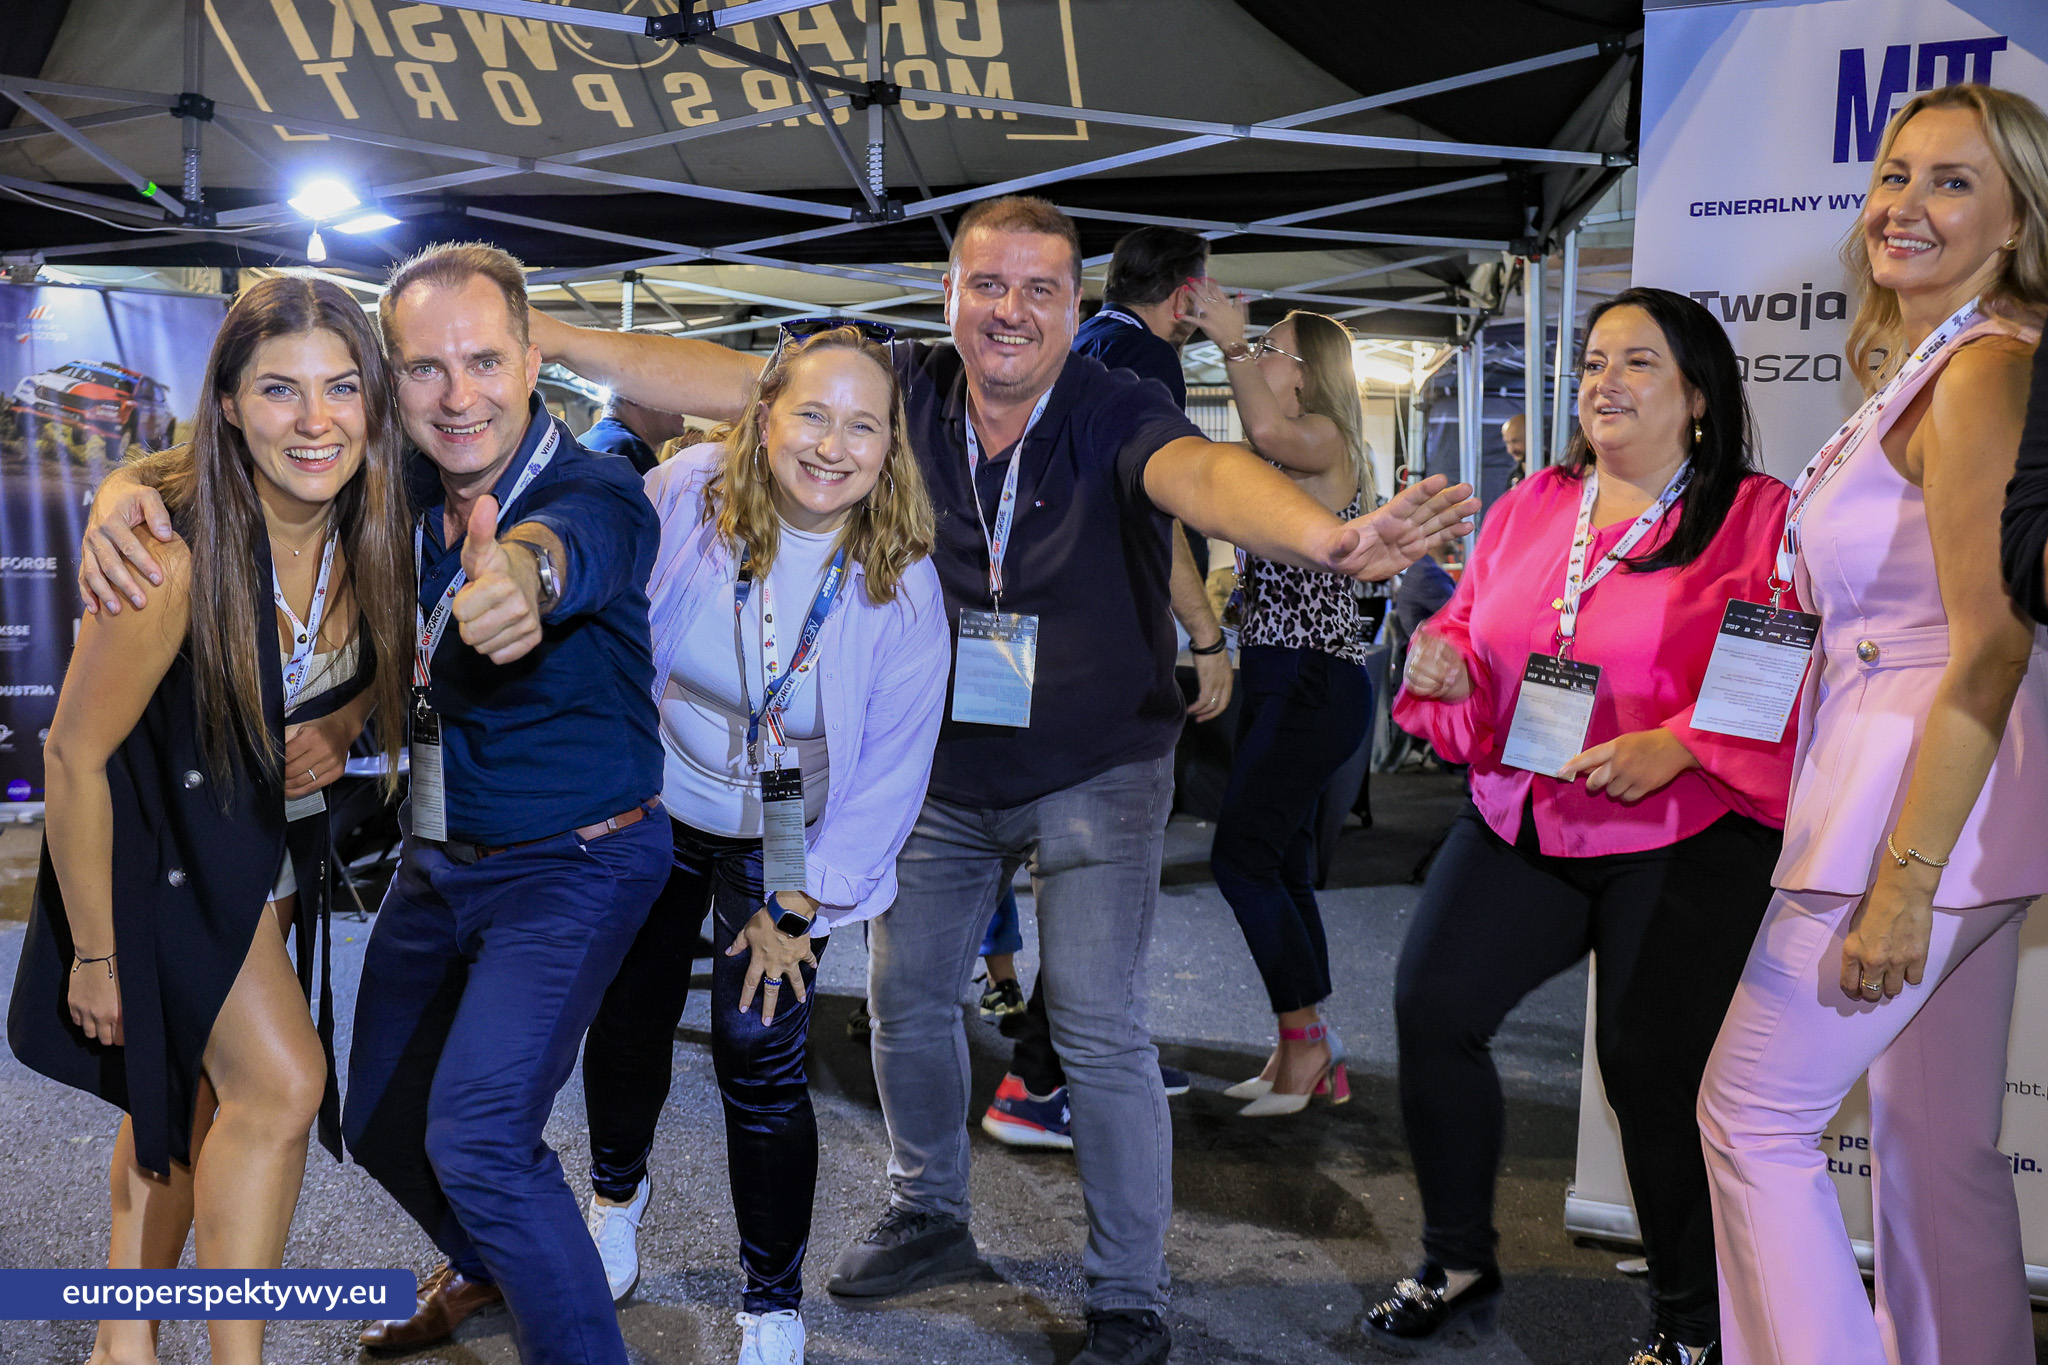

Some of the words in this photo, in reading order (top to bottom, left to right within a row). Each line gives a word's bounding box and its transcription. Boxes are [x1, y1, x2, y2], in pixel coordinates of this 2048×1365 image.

[1690, 196, 1823, 217] GENERALNY
[1690, 283, 1847, 330] Twoja
[1735, 353, 1842, 383] asza
[421, 603, 444, 646] GKFORGE
[2006, 1081, 2048, 1100] mbt.
[2008, 1152, 2043, 1174] ja.
